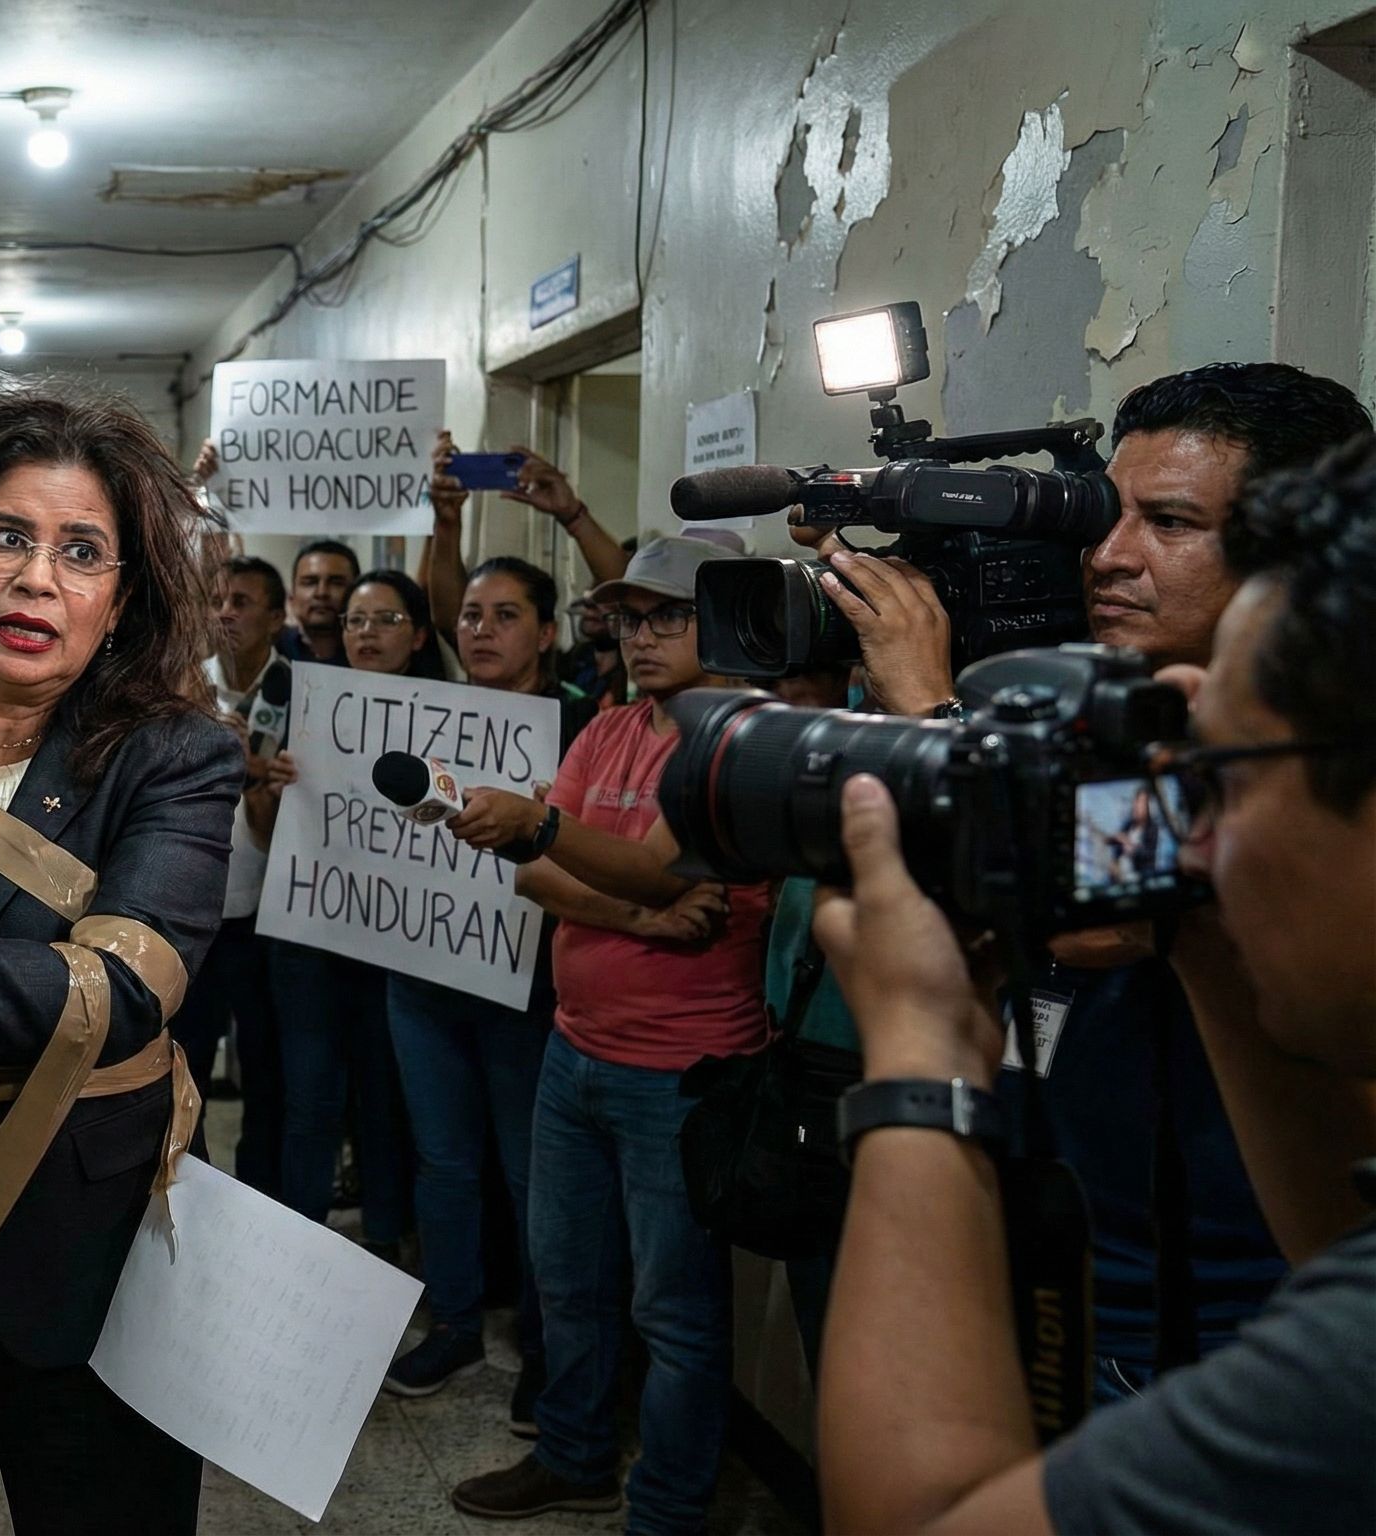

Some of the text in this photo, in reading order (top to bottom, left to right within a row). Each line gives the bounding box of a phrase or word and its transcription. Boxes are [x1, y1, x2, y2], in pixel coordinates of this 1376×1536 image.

[228, 378, 419, 417] FORMANDE
[220, 427, 418, 464] BURIOACURA
[226, 473, 433, 511] EN HONDURA
[286, 854, 528, 974] HONDURAN
